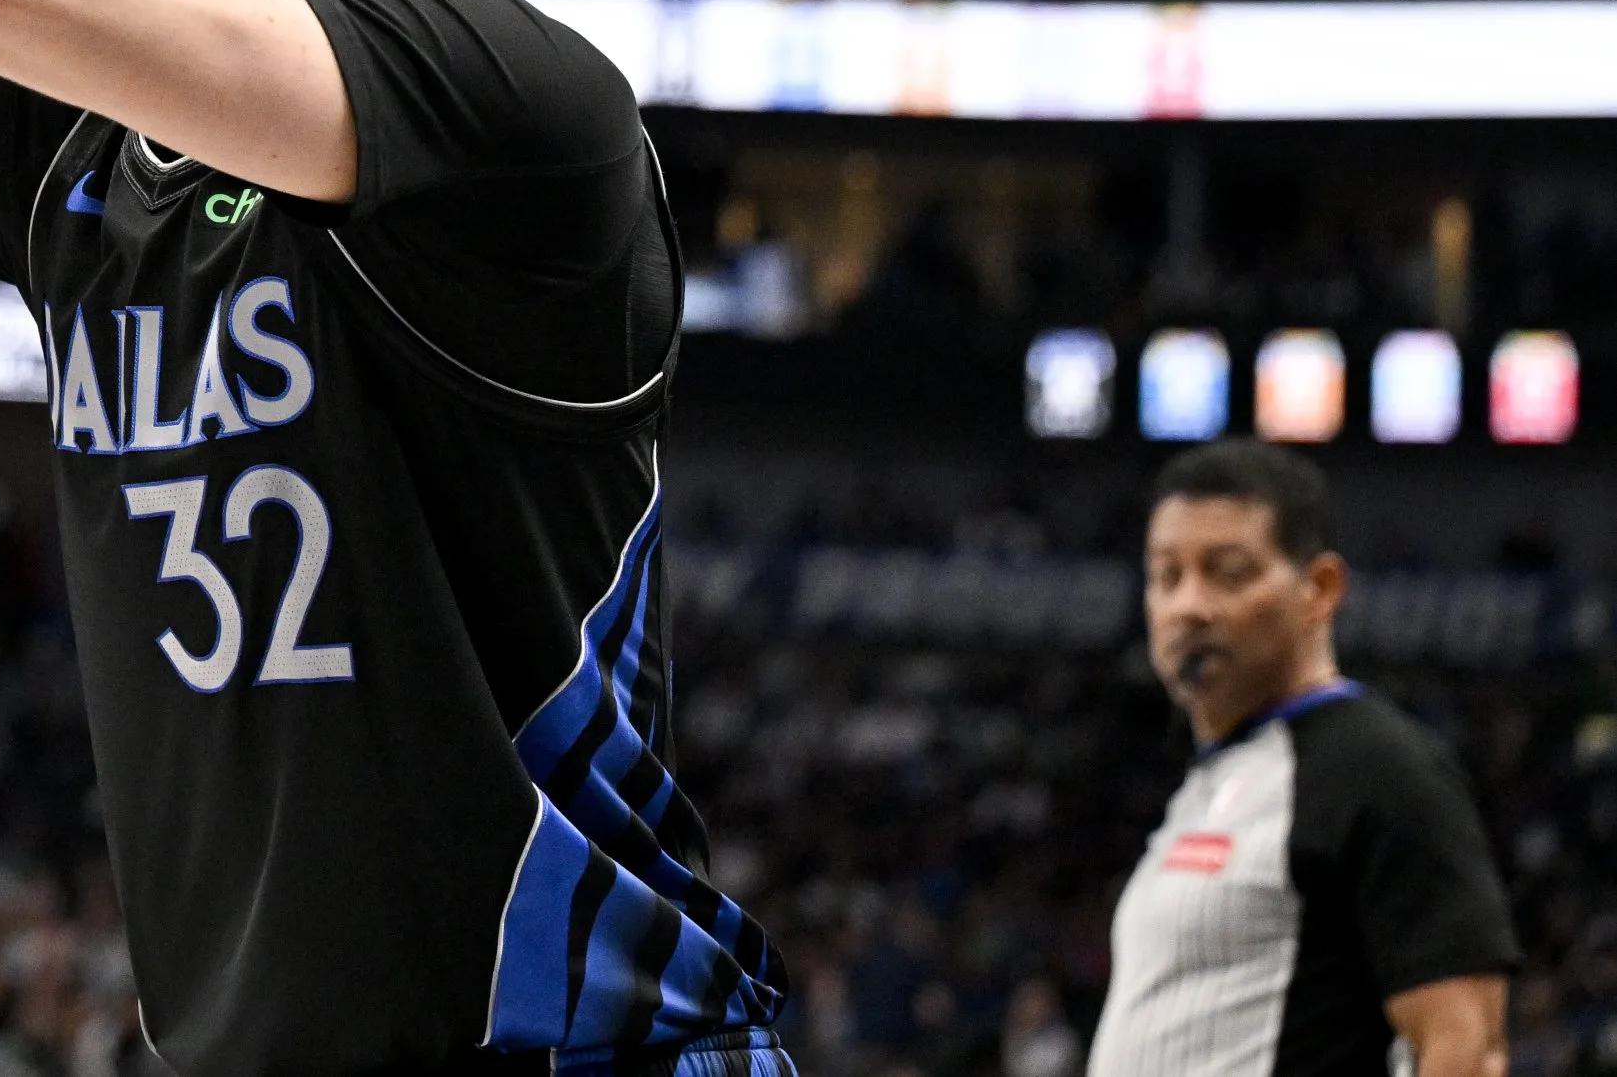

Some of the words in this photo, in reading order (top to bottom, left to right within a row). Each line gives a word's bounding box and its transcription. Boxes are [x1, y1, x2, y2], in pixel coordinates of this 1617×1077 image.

[205, 188, 264, 224] ch
[44, 276, 315, 456] ALAS
[121, 463, 356, 694] 32
